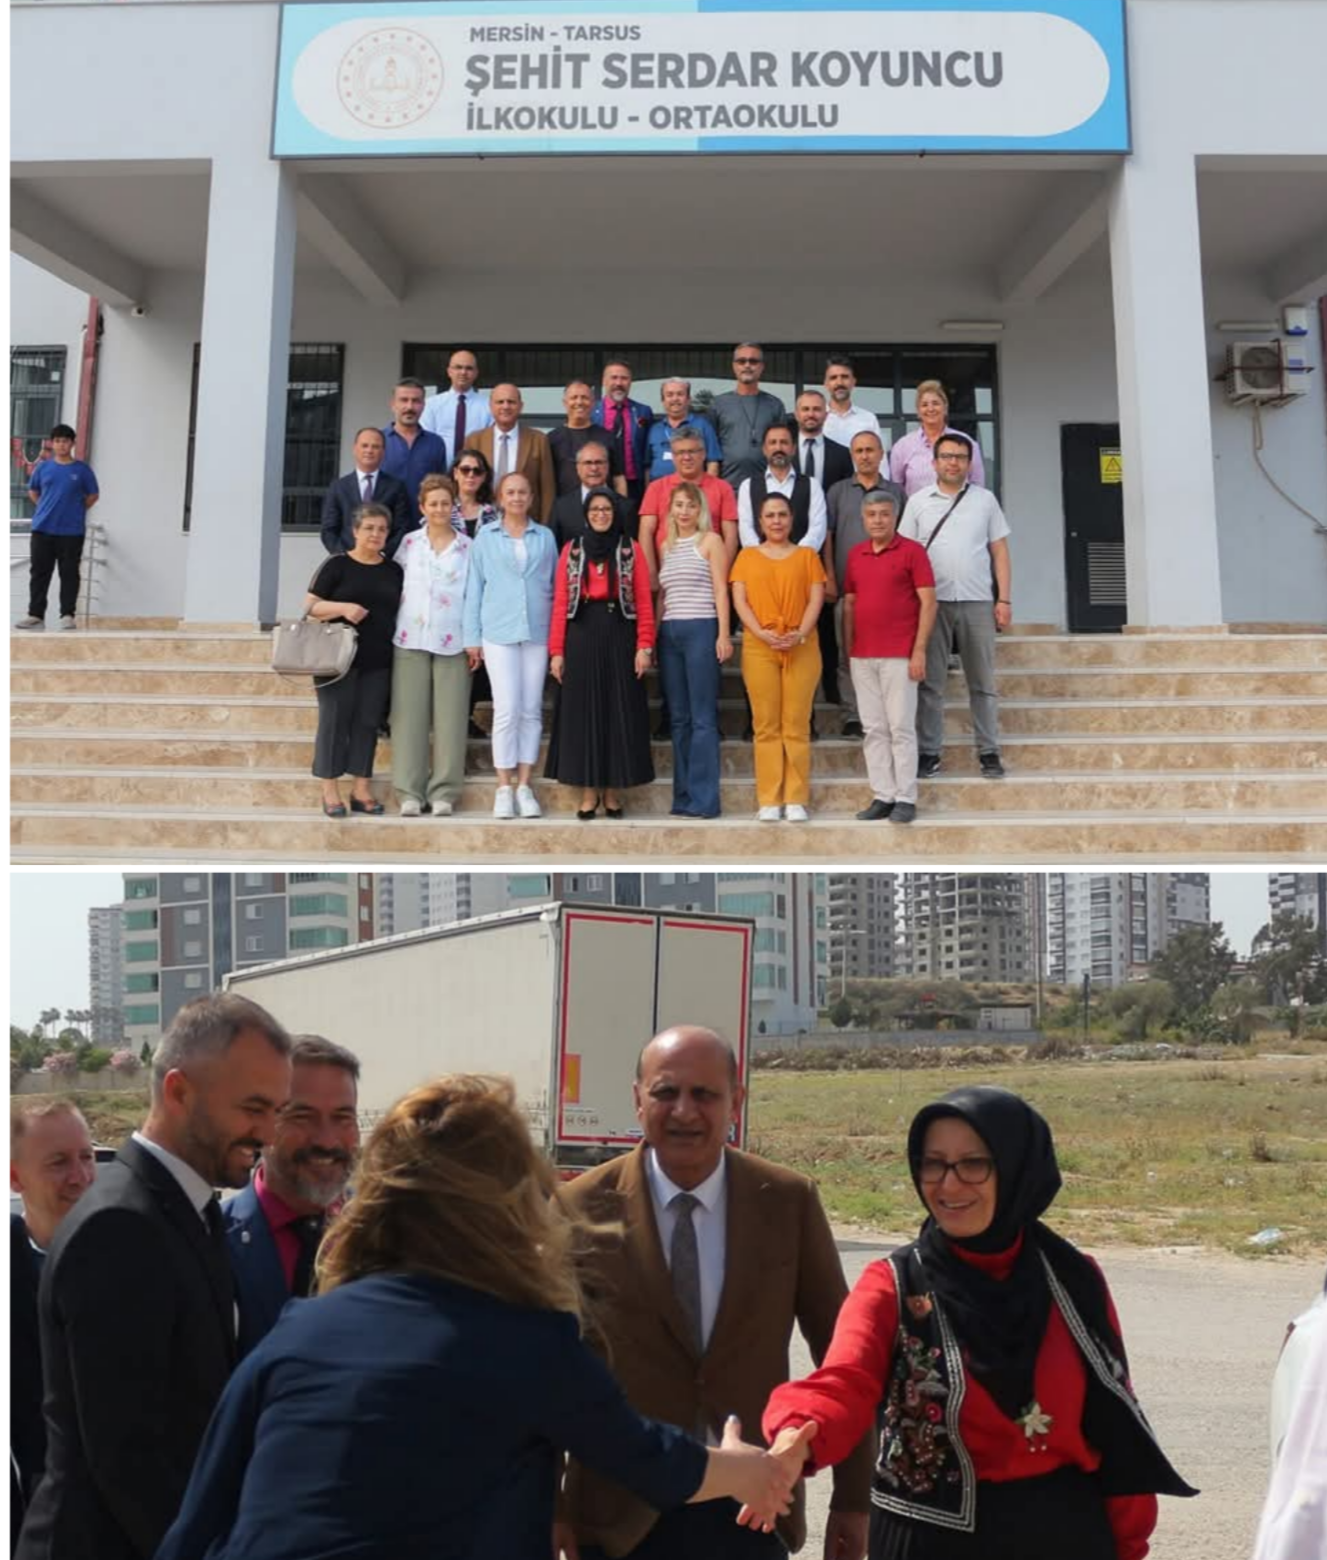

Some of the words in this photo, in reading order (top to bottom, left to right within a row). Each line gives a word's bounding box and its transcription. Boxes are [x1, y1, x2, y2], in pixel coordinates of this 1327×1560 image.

[469, 23, 545, 43] MERSİN
[562, 24, 642, 41] TARSUS
[464, 45, 591, 98] ŞEHİT
[601, 51, 778, 90] SERDAR
[791, 50, 1004, 89] KOYUNCU
[466, 102, 619, 131] İLKOKULU
[648, 103, 839, 130] ORTAOKULU
